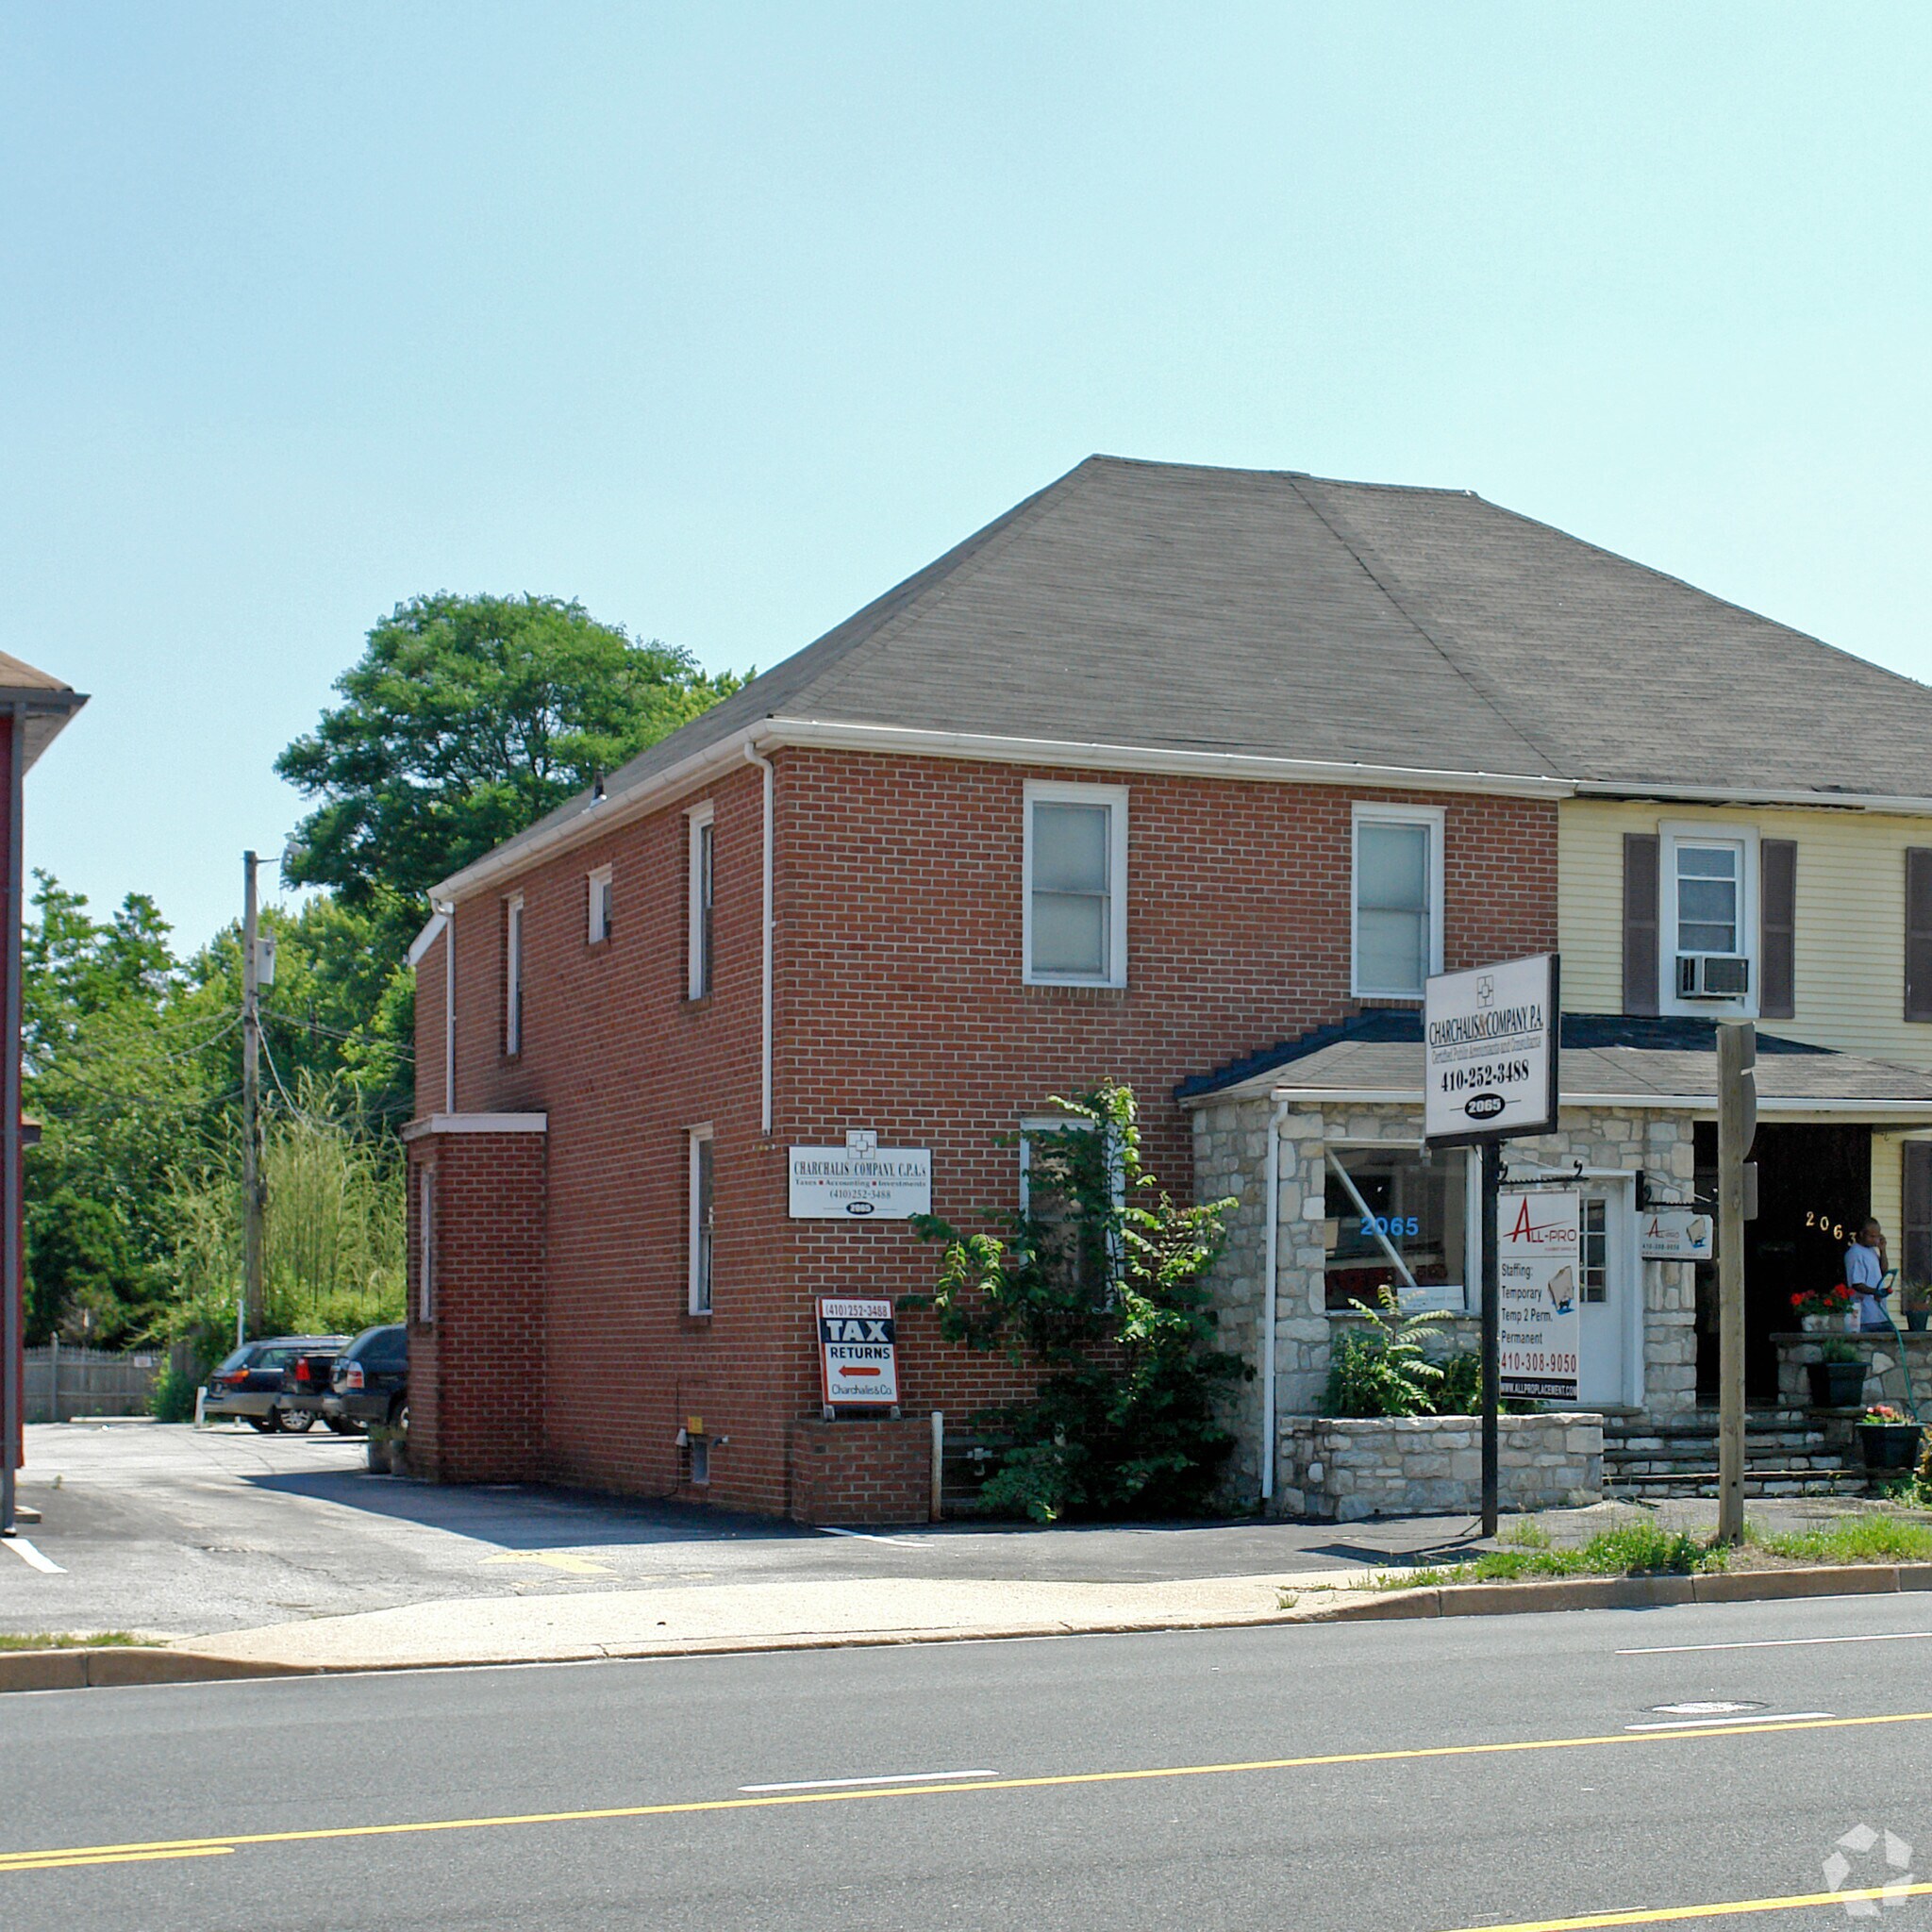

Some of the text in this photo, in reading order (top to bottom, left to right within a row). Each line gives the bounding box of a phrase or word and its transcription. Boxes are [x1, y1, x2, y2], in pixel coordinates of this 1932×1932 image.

[1441, 1058, 1529, 1091] 410-252-3488
[1468, 1098, 1502, 1113] 2065
[794, 1160, 849, 1175] CHARCHALIS
[825, 1179, 871, 1188] Accounting
[878, 1179, 926, 1188] Investments
[1360, 1217, 1419, 1236] 2065
[1806, 1211, 1857, 1246] 2063
[1502, 1263, 1533, 1280] Staffing:
[1502, 1285, 1542, 1303] Temporary
[1502, 1307, 1553, 1324] Temp 2 Perm.
[825, 1320, 889, 1341] TAX
[1502, 1330, 1542, 1344] Permanent
[830, 1346, 891, 1359] RETURNS
[1502, 1352, 1576, 1373] 410-308-9050
